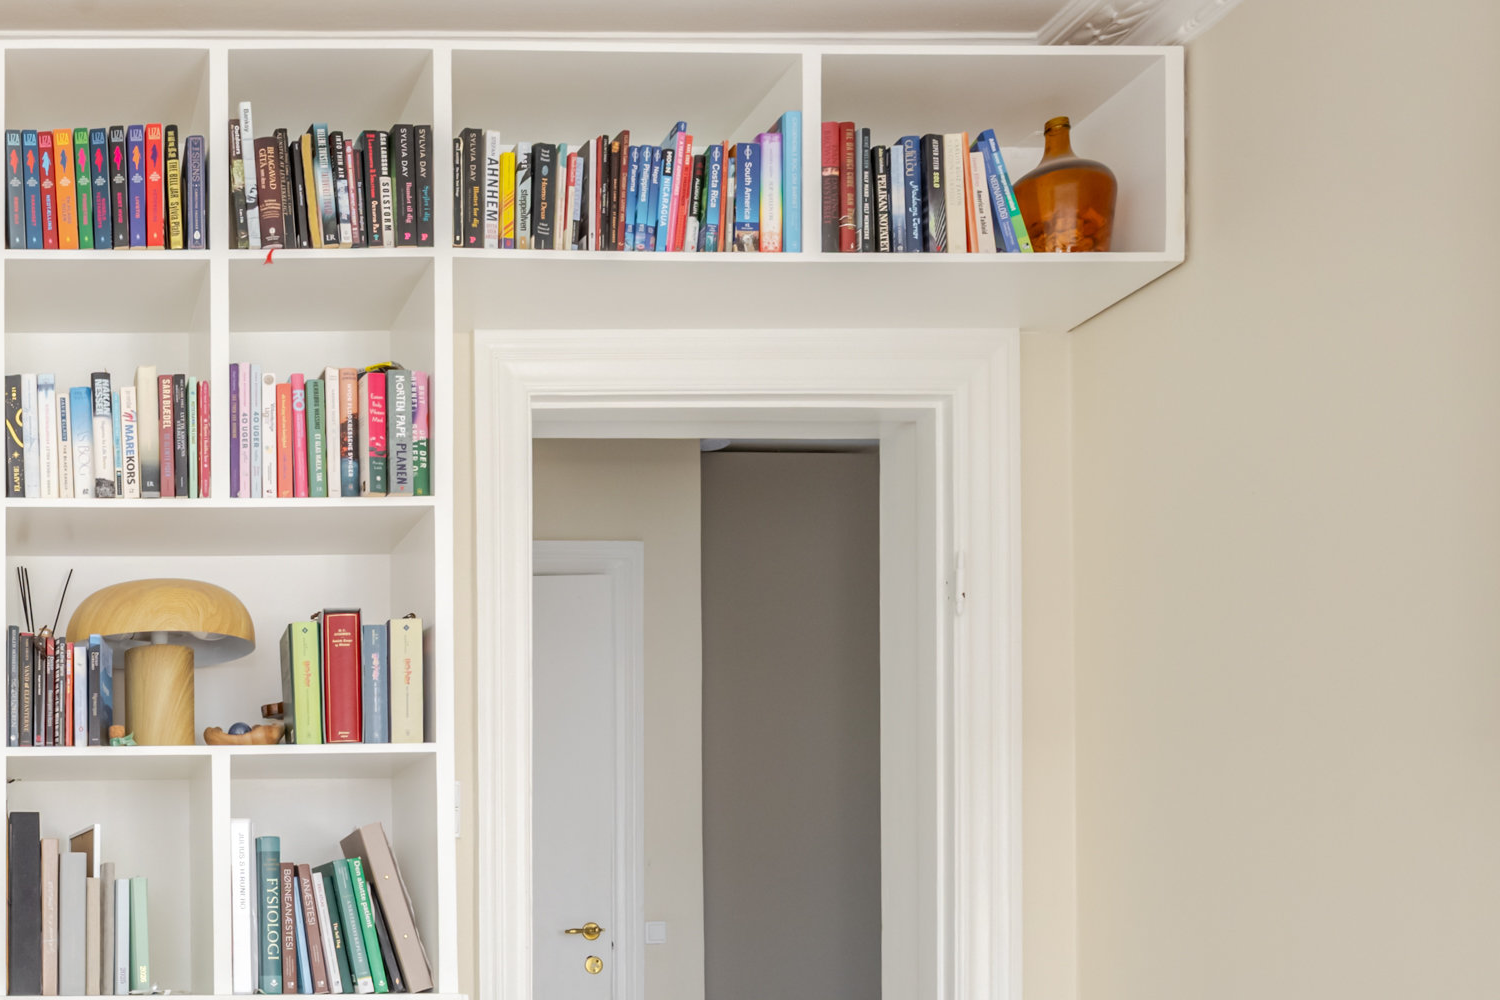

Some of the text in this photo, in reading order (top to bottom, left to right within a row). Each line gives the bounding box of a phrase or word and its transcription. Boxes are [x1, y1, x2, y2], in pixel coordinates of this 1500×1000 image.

[242, 108, 250, 132] Banksy
[276, 133, 284, 159] KUNSTEN
[381, 147, 389, 176] LARSSON
[400, 128, 409, 177] SYLVIA DAY
[418, 128, 427, 178] SYLVIA DAY
[469, 133, 477, 181] SYLVIA DAY
[168, 161, 178, 171] THE
[169, 173, 178, 186] BELL
[192, 152, 200, 182] SIGNS
[266, 146, 276, 190] BHAGAVAD
[630, 164, 639, 192] Panama
[641, 163, 650, 202] Philippines
[652, 166, 660, 184] Nepal
[170, 188, 179, 198] JAR
[487, 157, 498, 221] AHNHEM
[660, 177, 670, 227] NICARAGUA
[710, 163, 719, 208] Costa Rica
[744, 187, 752, 220] America
[909, 180, 919, 216] Madame
[989, 174, 1008, 219] NEONATOLOGI
[169, 202, 180, 220] Sylvia
[382, 182, 392, 231] SOLSTORM
[404, 213, 413, 224] dig
[422, 211, 431, 222] dig
[471, 218, 479, 228] dig
[518, 189, 528, 232] steppeulven
[877, 174, 889, 252] PELIKAN NOTATET
[976, 190, 988, 235] American Tabloid
[171, 221, 180, 237] Plath
[94, 379, 103, 416] NESSER
[162, 379, 171, 429] SARA BLÆDEL
[293, 389, 305, 412] RO
[242, 413, 248, 423] 40
[253, 411, 259, 422] 40
[395, 375, 407, 485] MORTEN PAPE PLANEN
[125, 424, 135, 485] MAREKORS
[419, 450, 427, 469] DER
[283, 868, 293, 951] BØRNEANÆSTESI
[302, 878, 316, 926] ANÆSTESI
[353, 860, 373, 928] Den akutte patient
[266, 877, 279, 961] FYSIOLOGI
